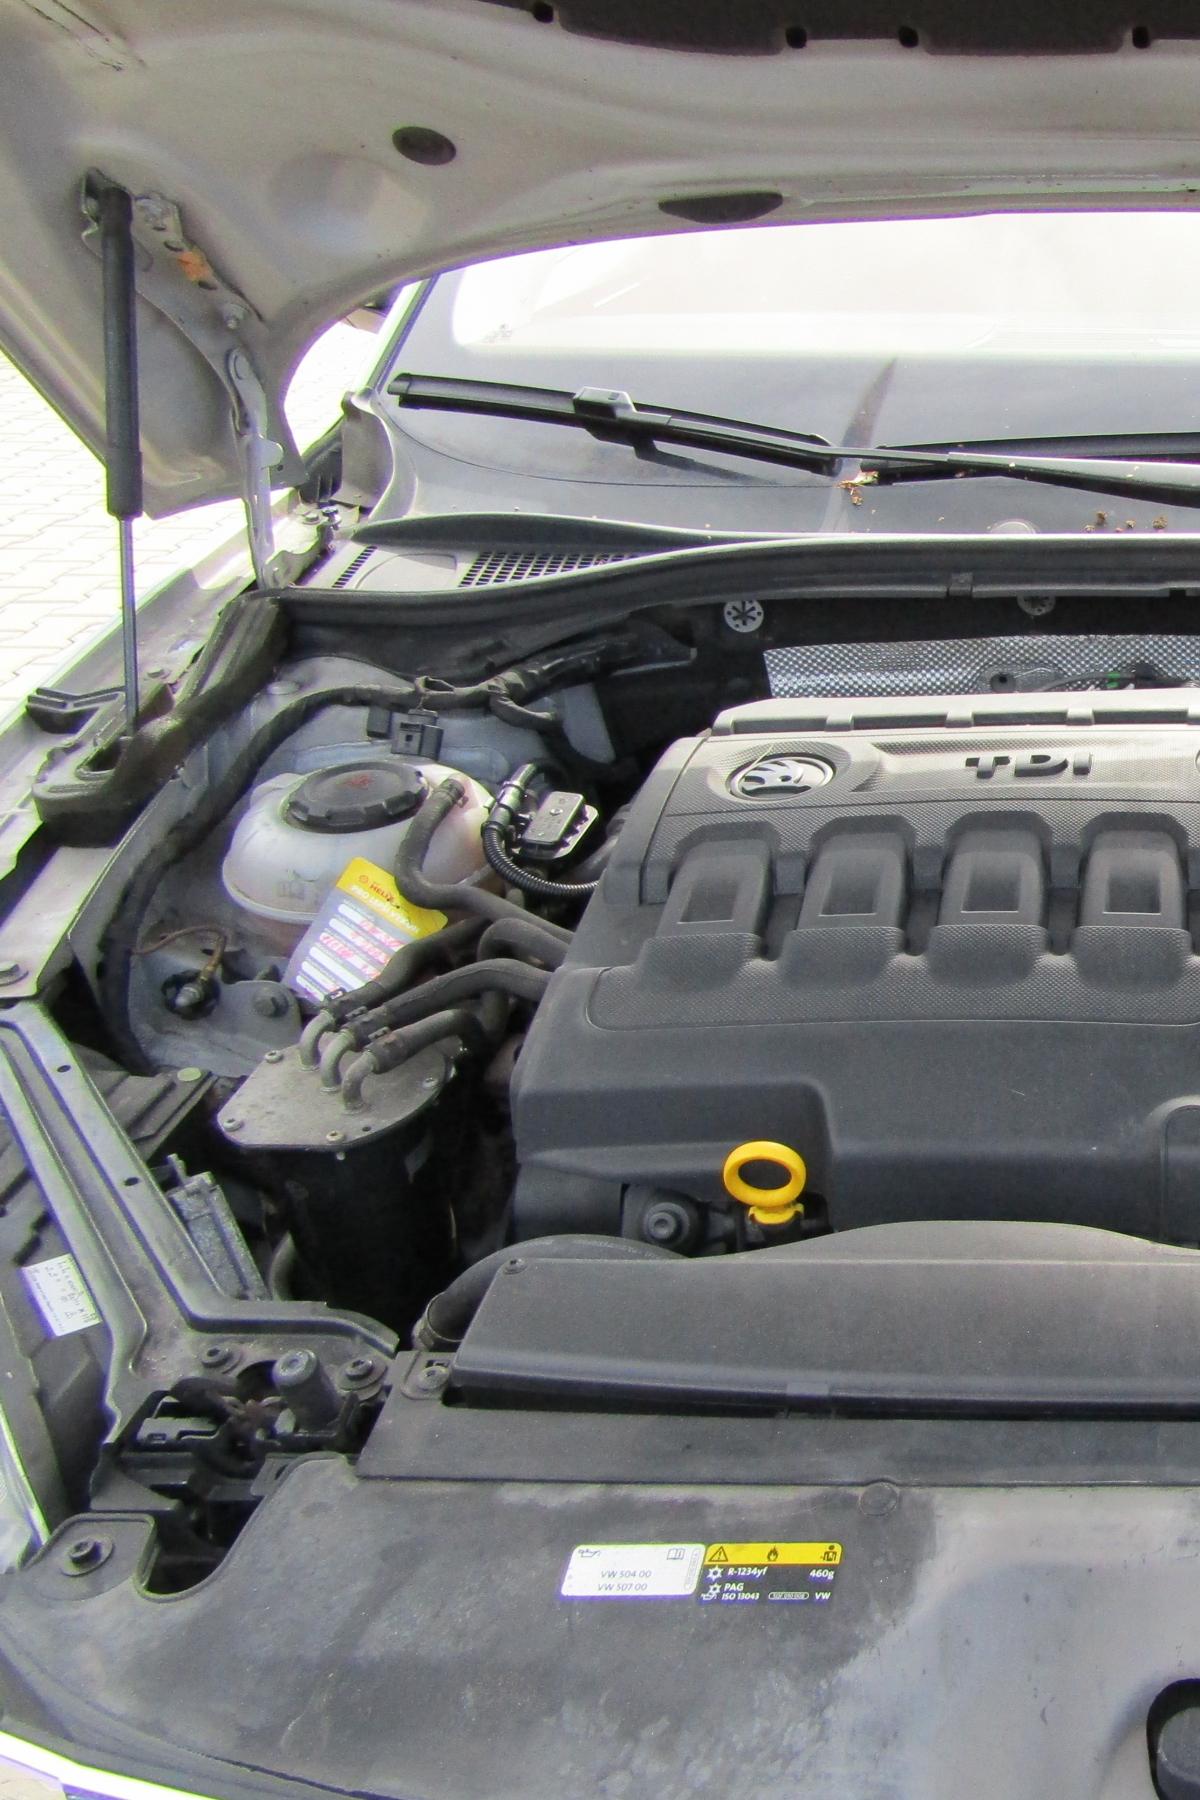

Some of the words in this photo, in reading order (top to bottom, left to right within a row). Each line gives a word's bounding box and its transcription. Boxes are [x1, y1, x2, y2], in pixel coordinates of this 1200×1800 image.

[965, 751, 1093, 779] TDI
[601, 1570, 618, 1578] VW
[620, 1570, 637, 1578] 504
[639, 1569, 652, 1578] 00
[727, 1566, 768, 1578] R-1234yf
[809, 1569, 835, 1580] 460g
[598, 1583, 615, 1591] VW
[617, 1583, 634, 1591] 507
[635, 1583, 648, 1591] 00
[723, 1583, 745, 1591] PAG
[815, 1592, 831, 1600] VW
